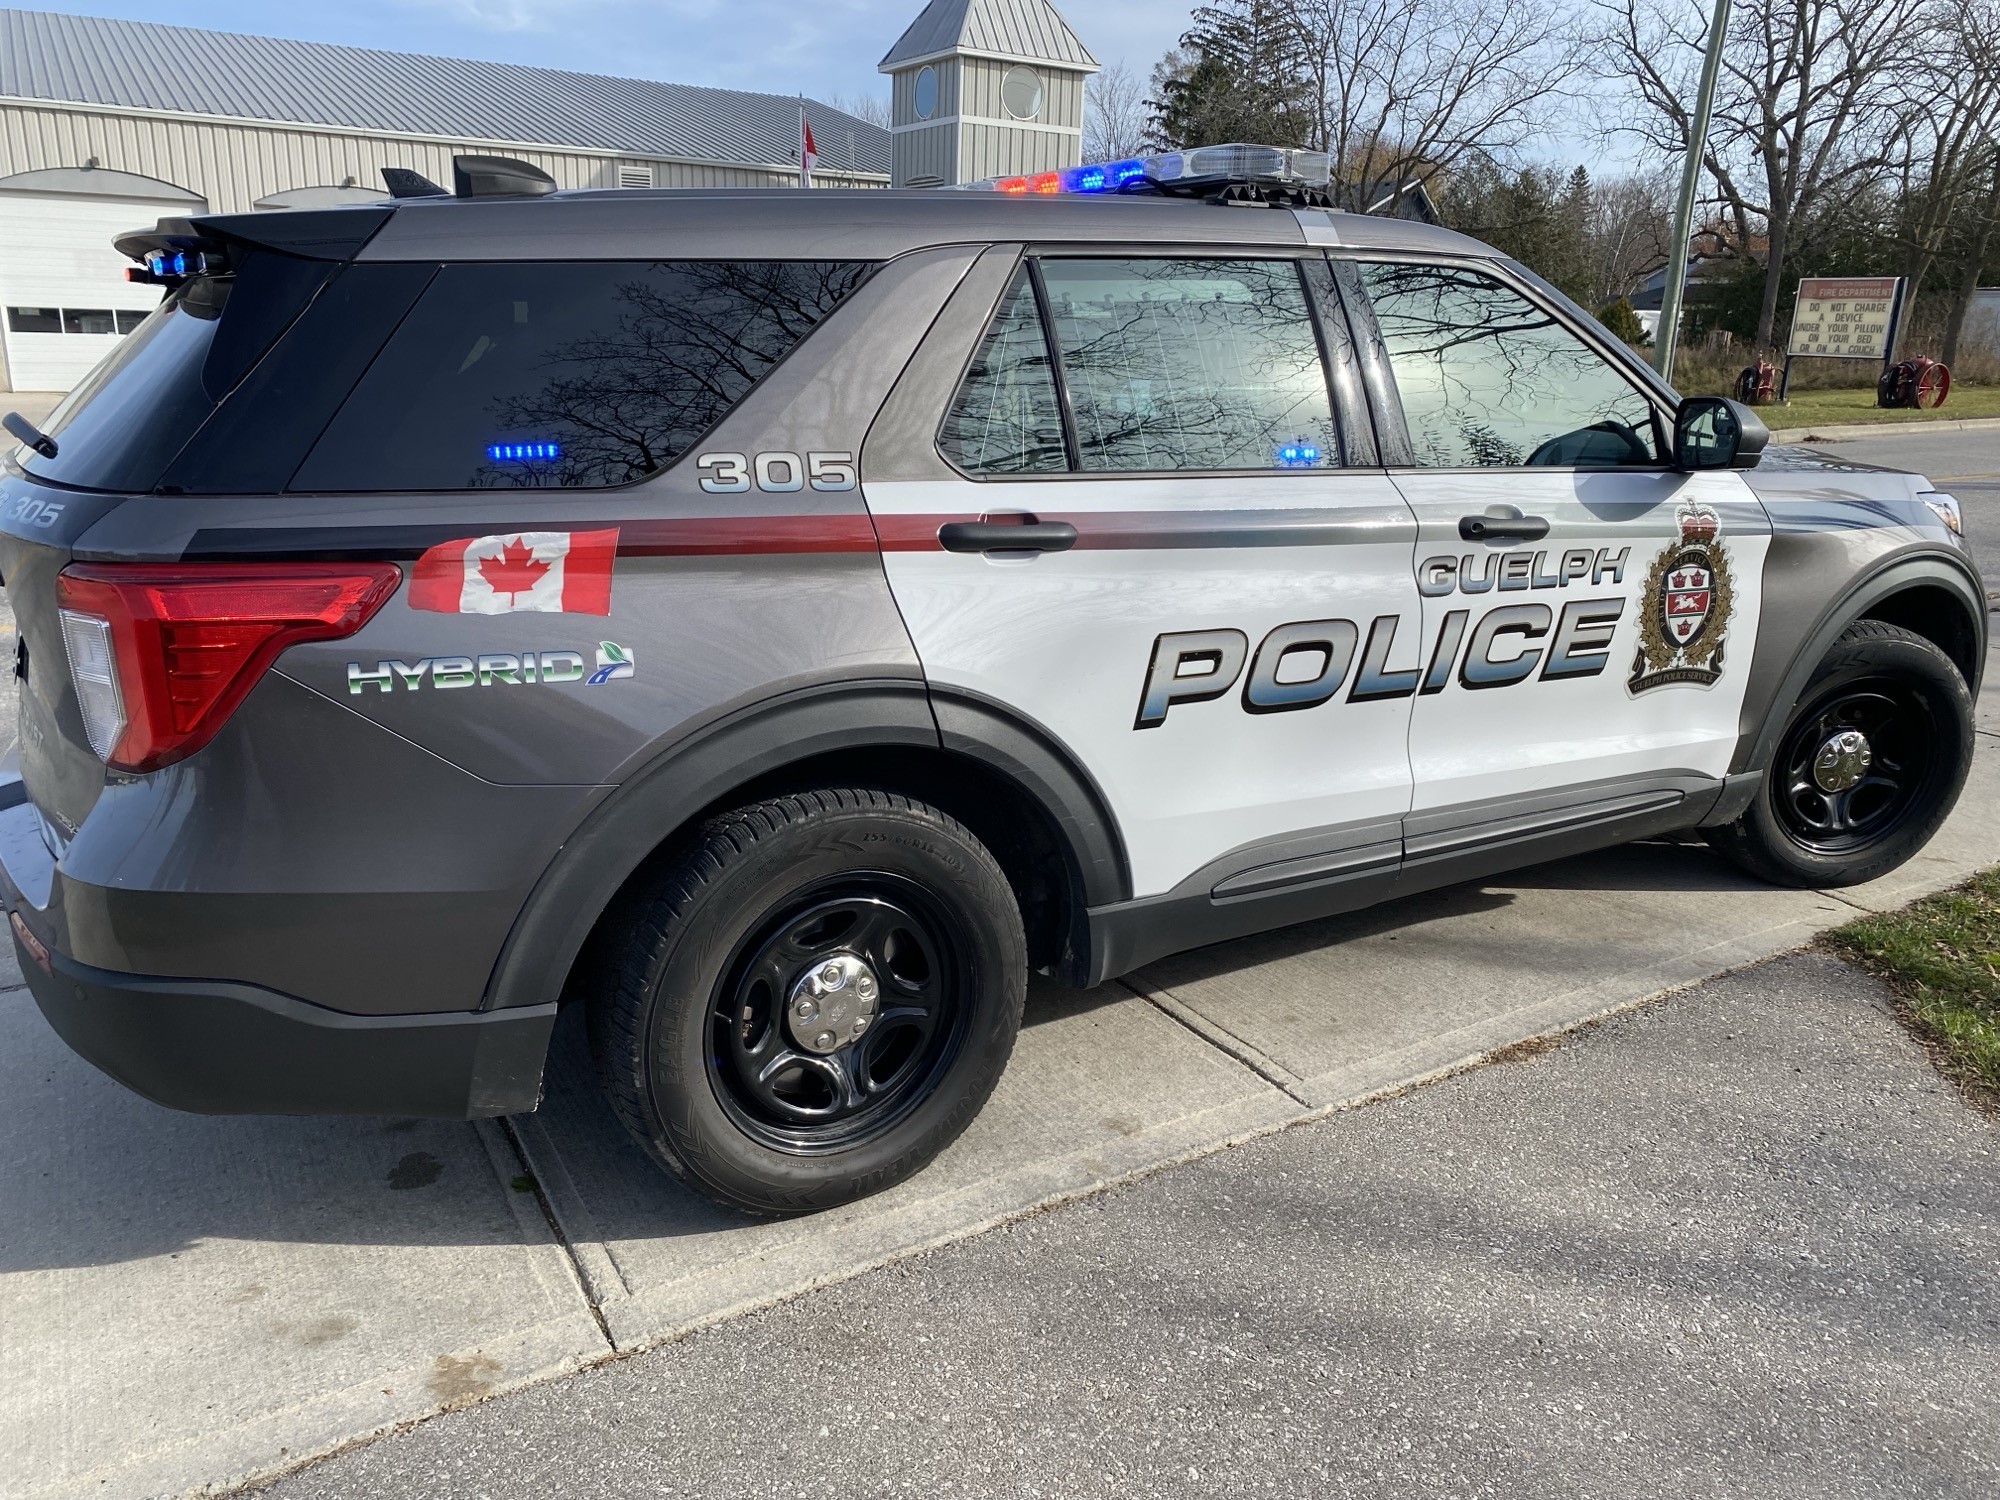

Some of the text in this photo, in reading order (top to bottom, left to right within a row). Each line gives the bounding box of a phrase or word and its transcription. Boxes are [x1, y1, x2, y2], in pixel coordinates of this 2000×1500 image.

[1820, 288, 1893, 297] FIRE DEPARTMENT
[1809, 302, 1887, 313] DO NOT CHARGE
[1819, 313, 1864, 322] A DEVICE
[1795, 323, 1885, 333] UNDER YOUR PILLOW
[1800, 344, 1876, 354] OR ON A COUCH
[1808, 334, 1872, 344] ON YOUR BED
[696, 450, 857, 494] 305
[7, 496, 66, 528] 305
[1420, 546, 1631, 597] GUELPH
[347, 650, 585, 694] HYBRID
[1132, 597, 1626, 731] POLICE
[1634, 671, 1715, 691] GUELPH POLICE SERVICE
[657, 993, 685, 1085] EAGLE
